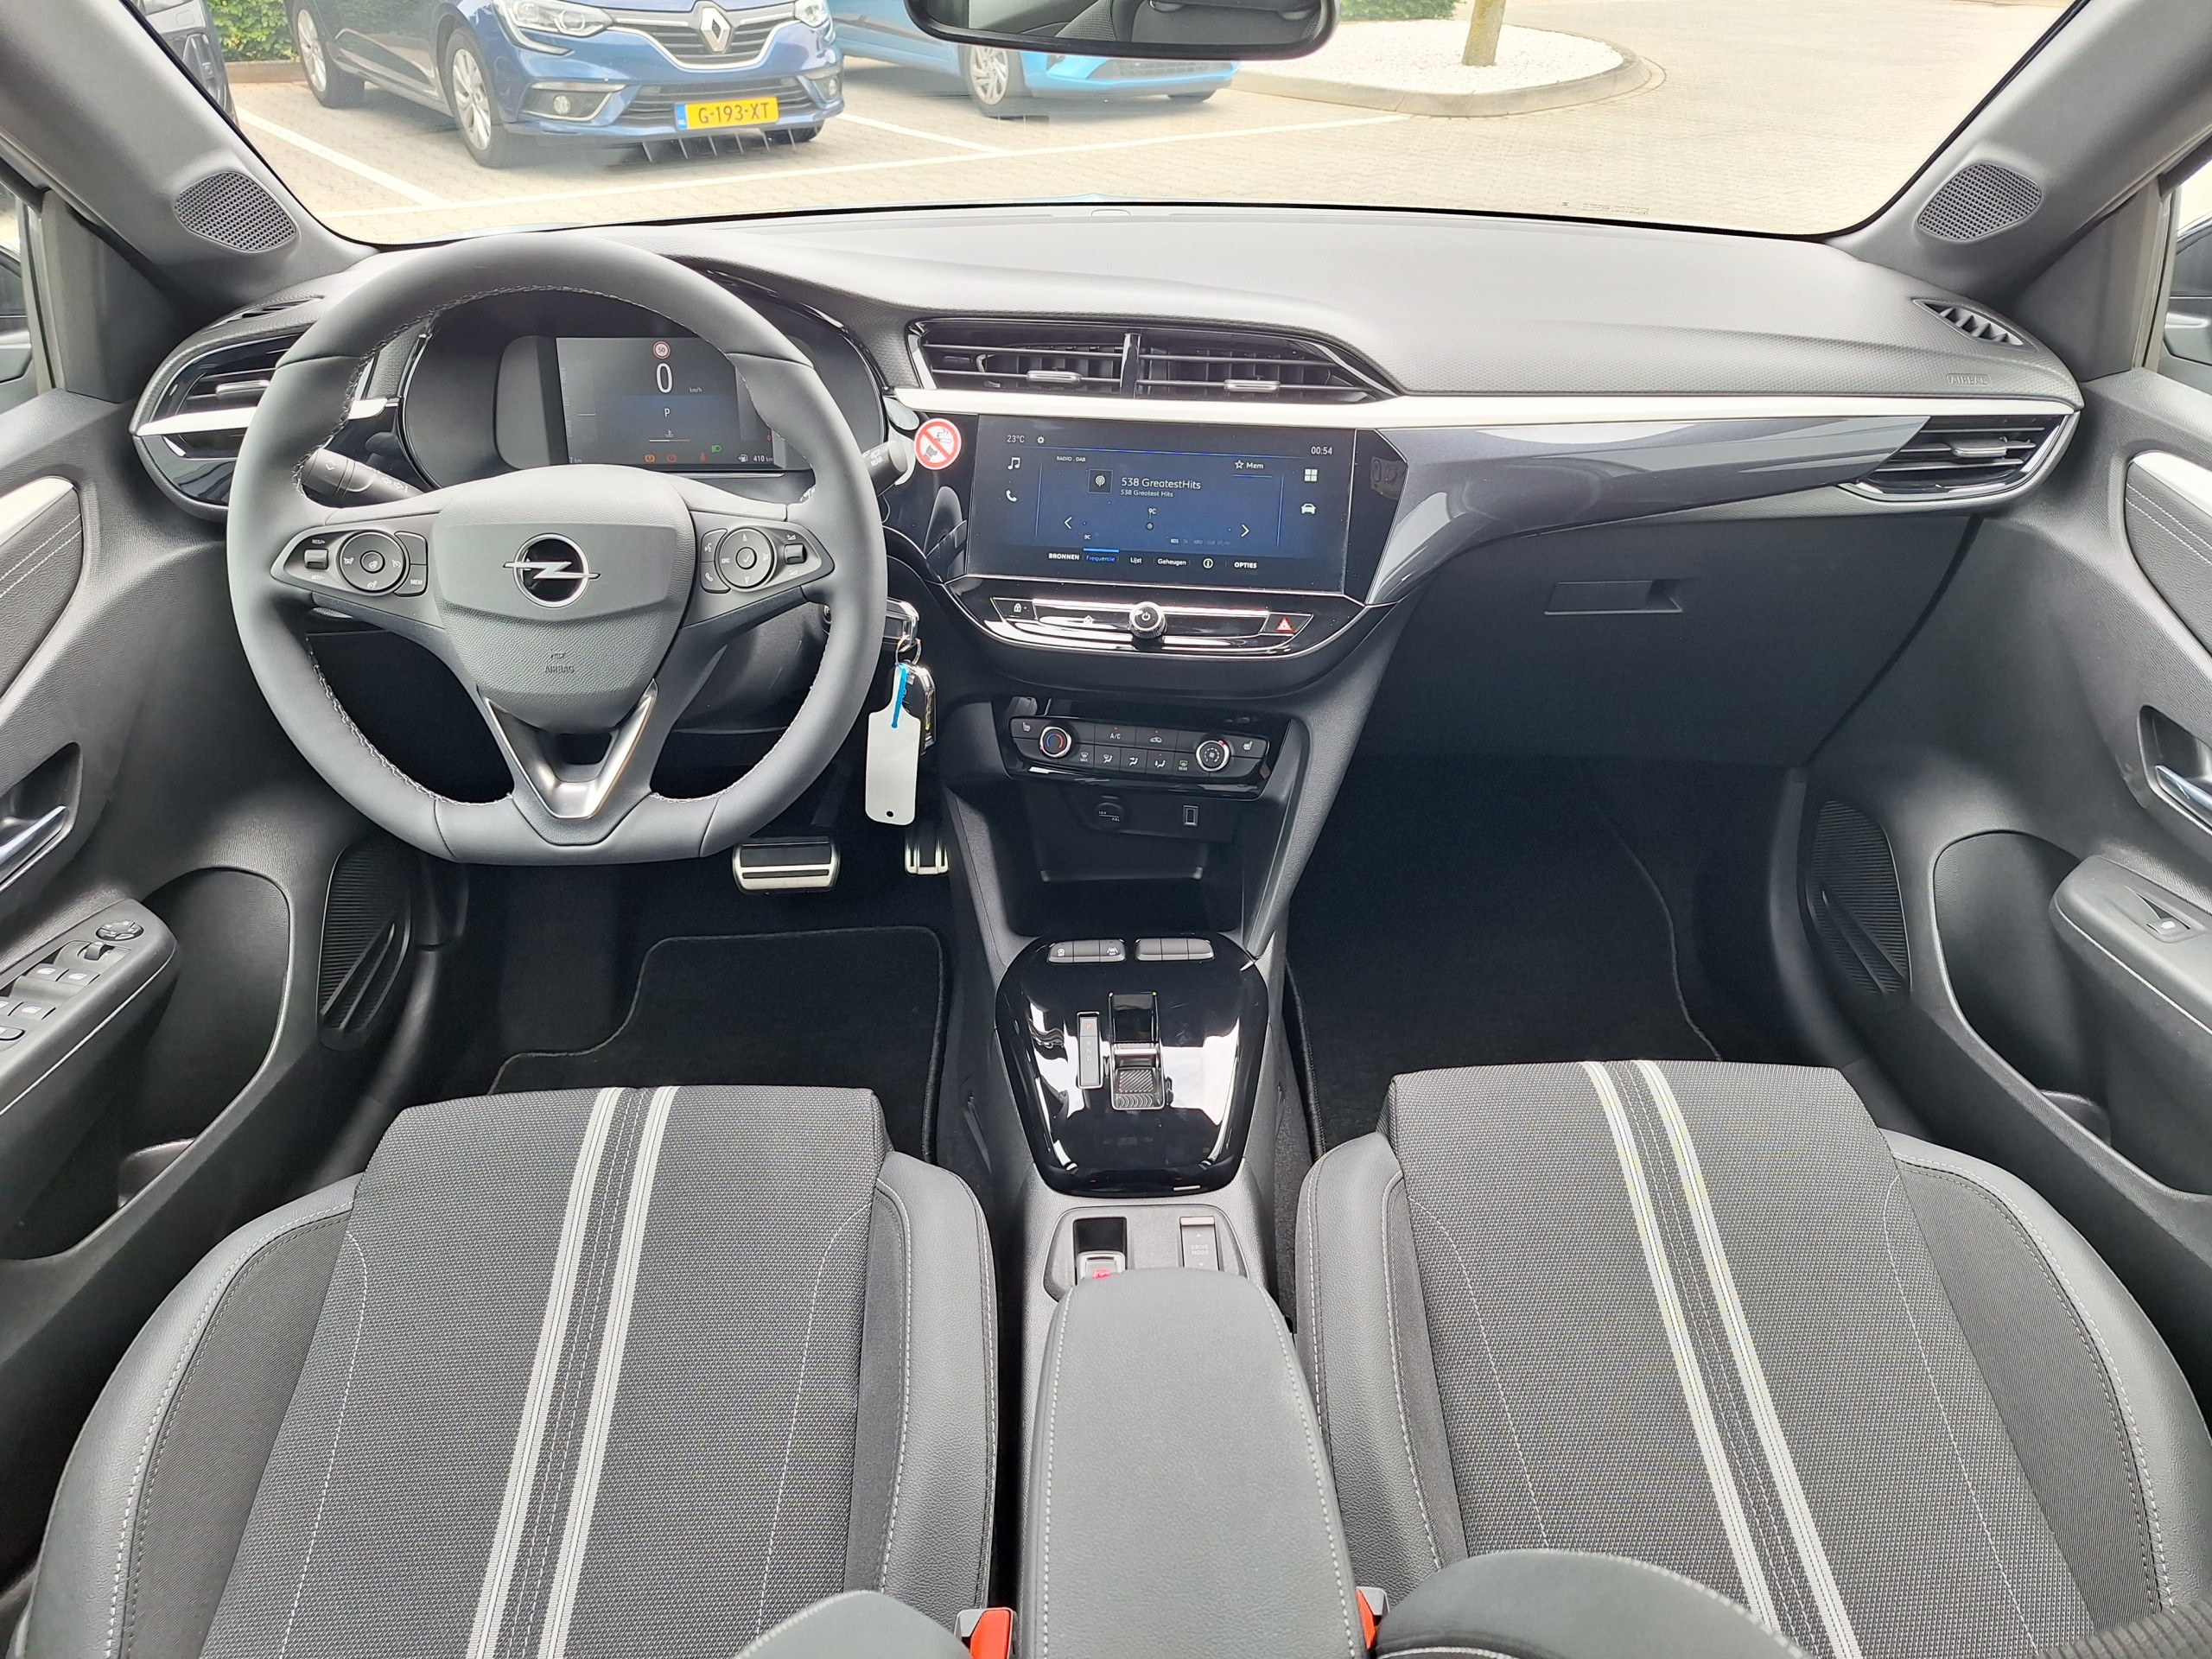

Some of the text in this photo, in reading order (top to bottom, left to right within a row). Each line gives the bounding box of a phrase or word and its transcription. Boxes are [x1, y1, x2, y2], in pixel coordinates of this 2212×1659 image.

[698, 102, 769, 124] G-193-XT
[656, 362, 673, 393] 0
[664, 408, 671, 418] P
[1310, 446, 1333, 455] 00:54
[1121, 477, 1202, 490] 538 GreatestHits
[1085, 555, 1116, 563] Frequentie
[1157, 558, 1187, 567] Geheugen
[1234, 561, 1258, 569] OPTIES
[543, 664, 575, 674] AIRBAG
